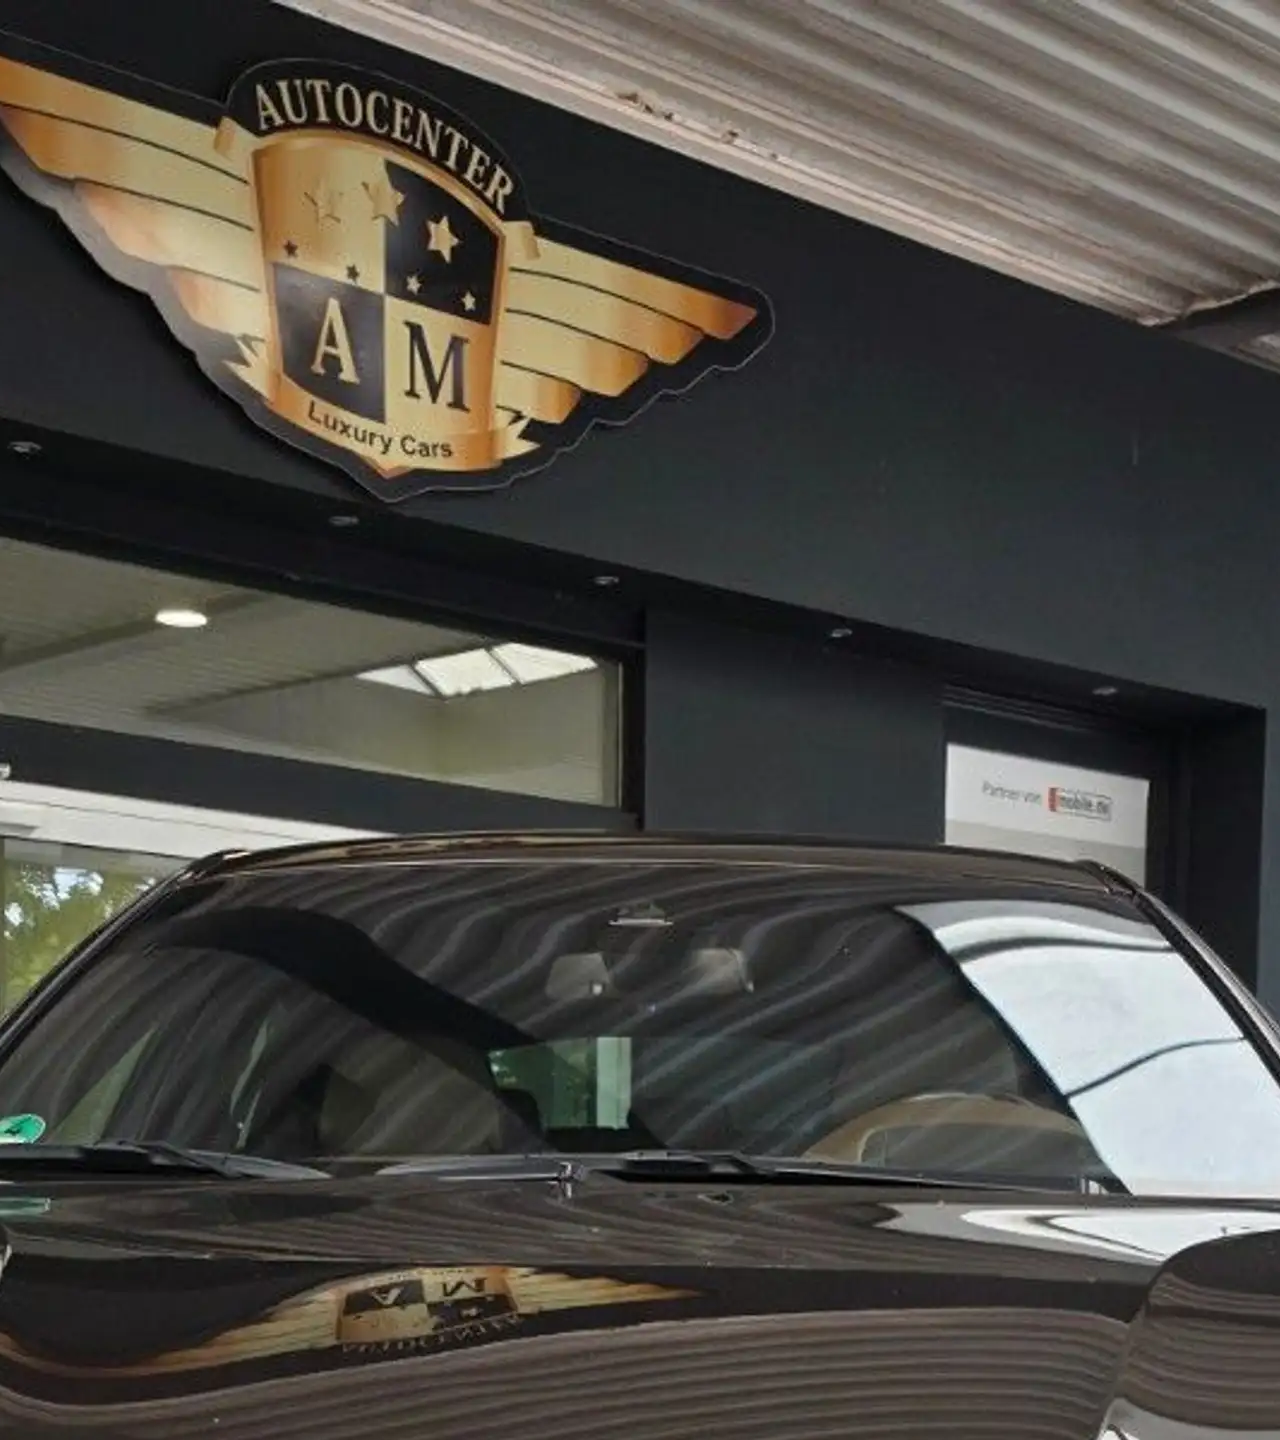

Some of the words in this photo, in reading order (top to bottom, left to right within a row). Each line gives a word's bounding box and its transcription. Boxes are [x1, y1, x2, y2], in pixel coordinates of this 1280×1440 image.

[255, 78, 514, 214] AUTOCENTER
[311, 297, 360, 385] A
[403, 320, 470, 414] M
[307, 400, 393, 456] Luxury
[401, 434, 453, 459] Cars
